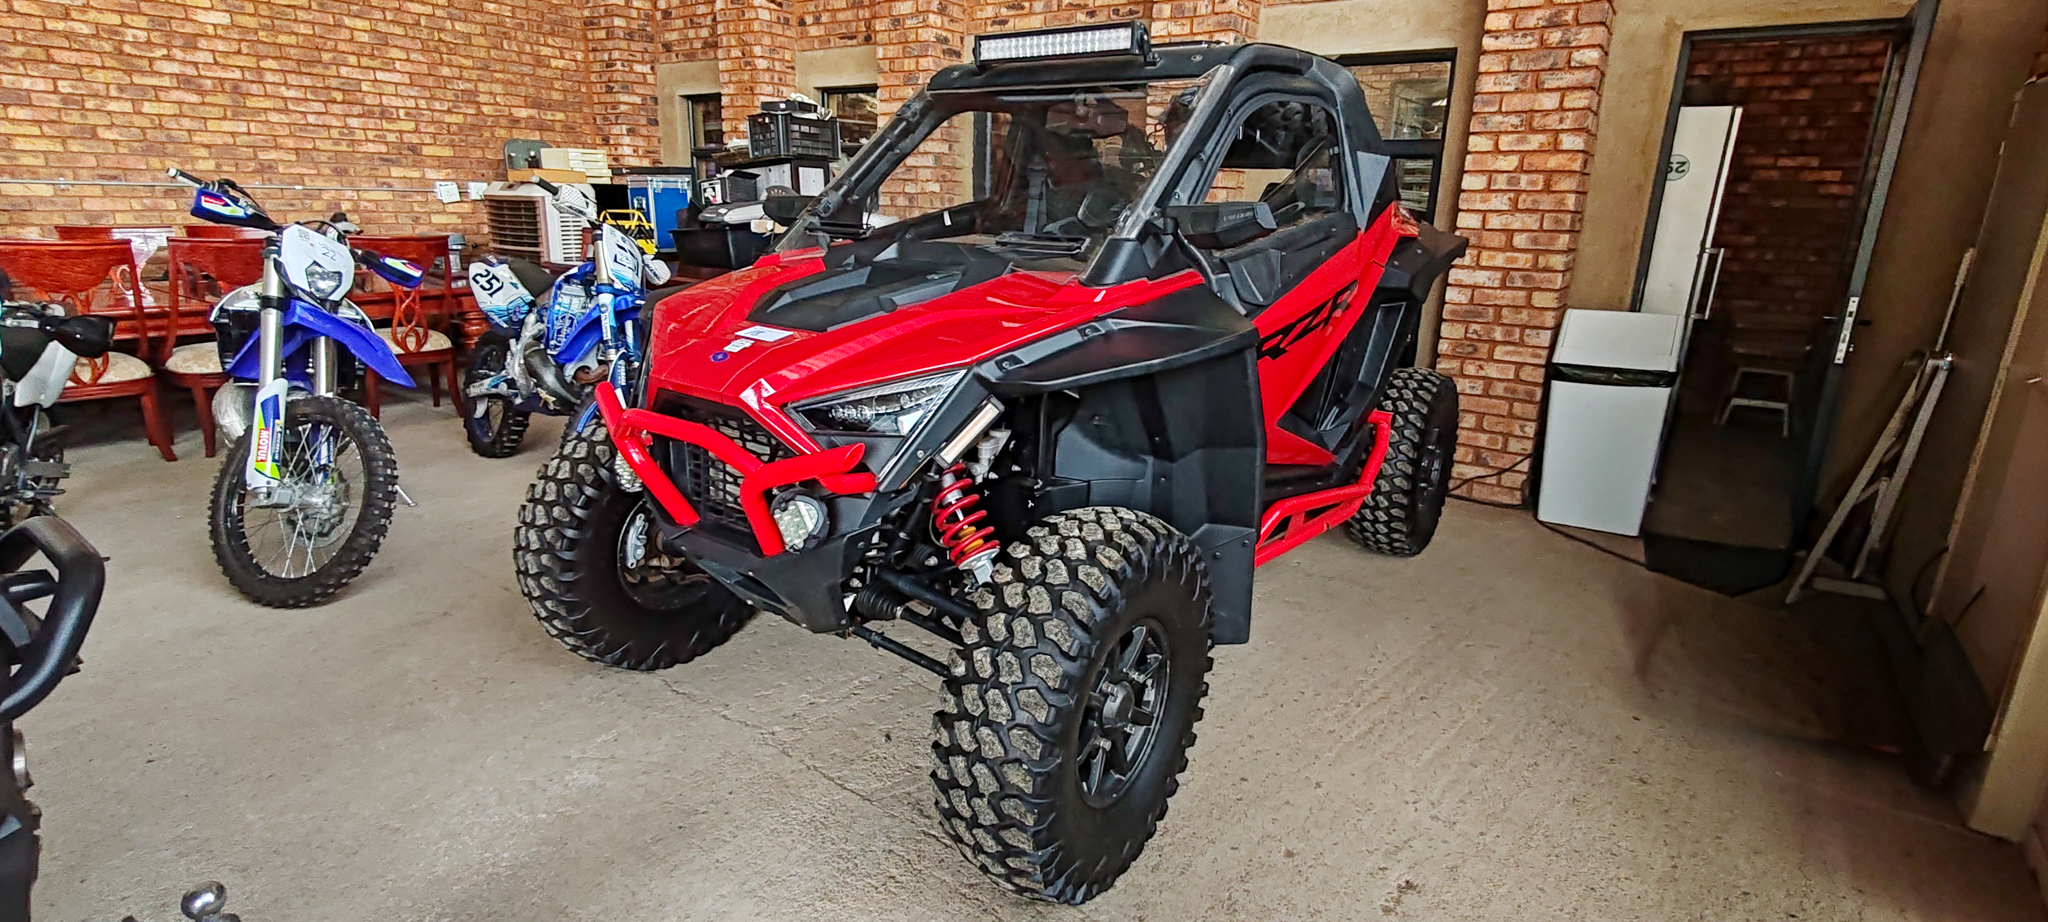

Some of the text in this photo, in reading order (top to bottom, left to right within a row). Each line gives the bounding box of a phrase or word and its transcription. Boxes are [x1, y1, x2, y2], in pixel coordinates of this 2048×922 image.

[321, 246, 337, 262] 22
[472, 268, 504, 298] 251
[1257, 279, 1359, 361] RZR
[257, 430, 270, 462] MOTUL
